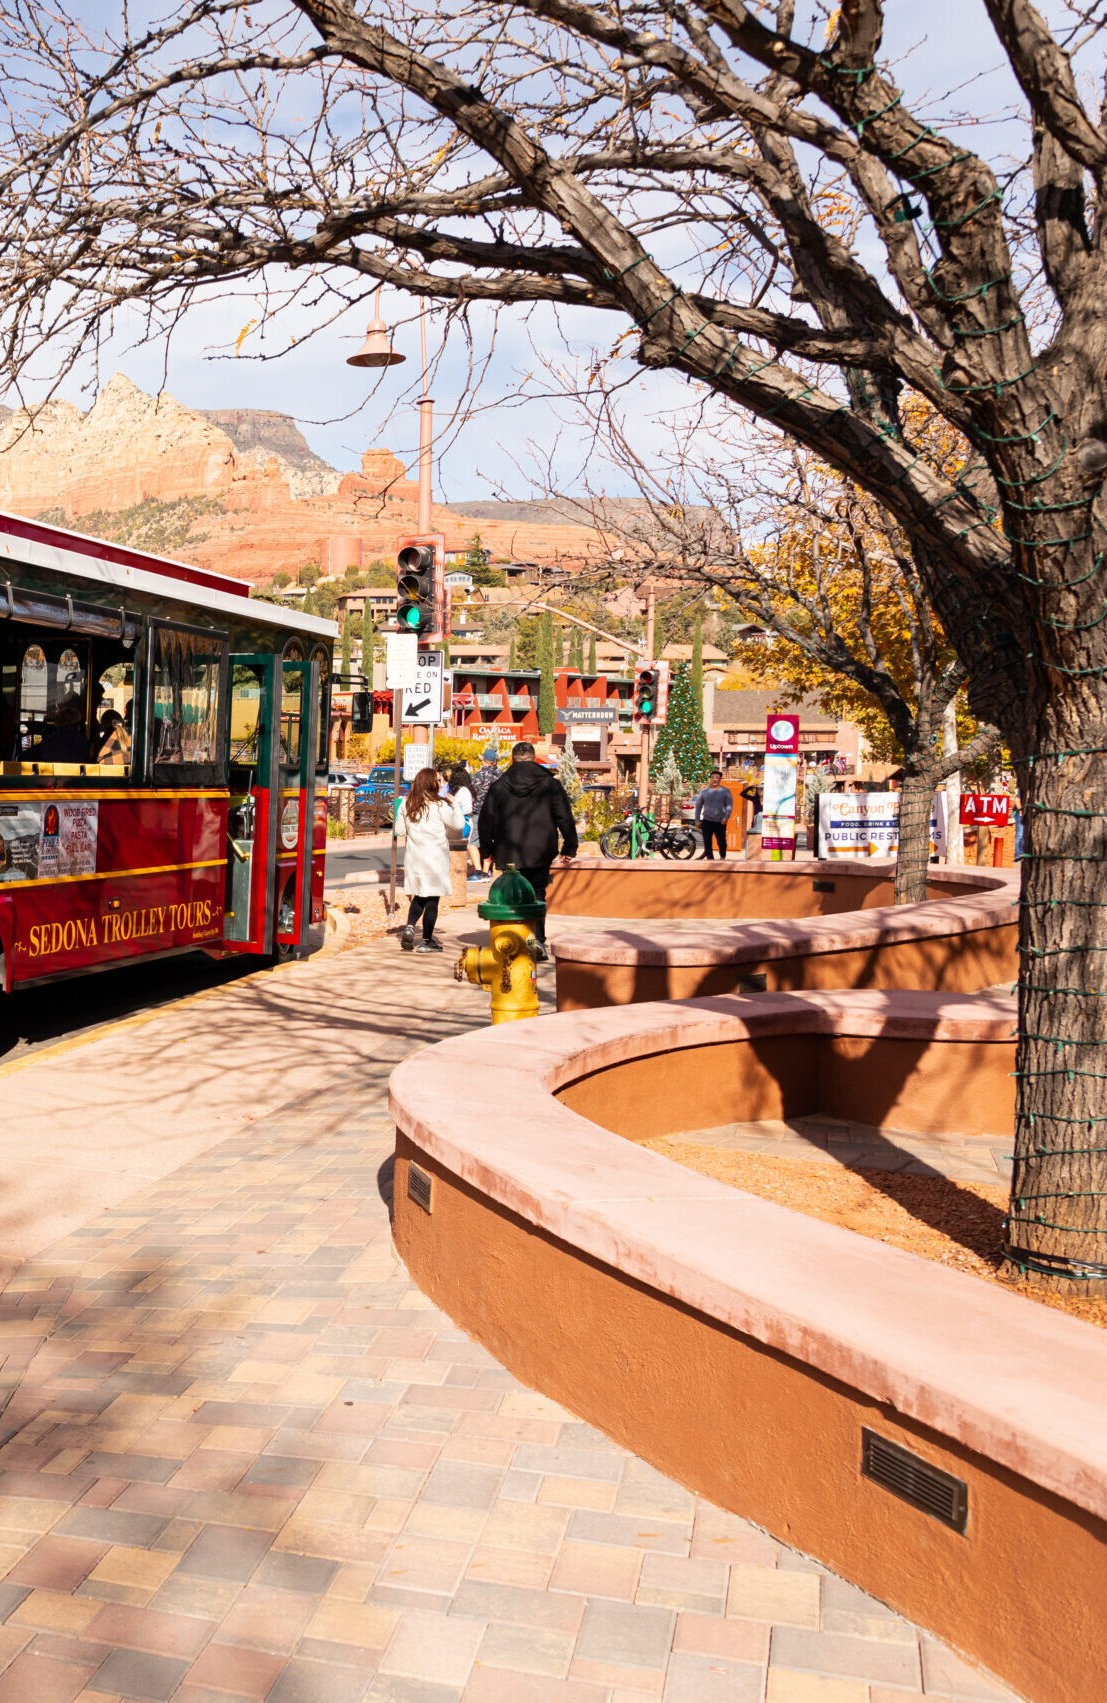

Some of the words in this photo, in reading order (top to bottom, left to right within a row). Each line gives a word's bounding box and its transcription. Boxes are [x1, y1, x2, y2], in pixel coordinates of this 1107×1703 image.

[418, 655, 436, 667] OP
[472, 732, 517, 741] Restrant
[769, 743, 794, 751] Uptown
[965, 796, 1008, 814] ATM
[824, 832, 867, 841] PUBLIC
[28, 917, 98, 957] SEDONA
[101, 906, 168, 944] TROLLEY
[168, 900, 212, 931] TOURS
